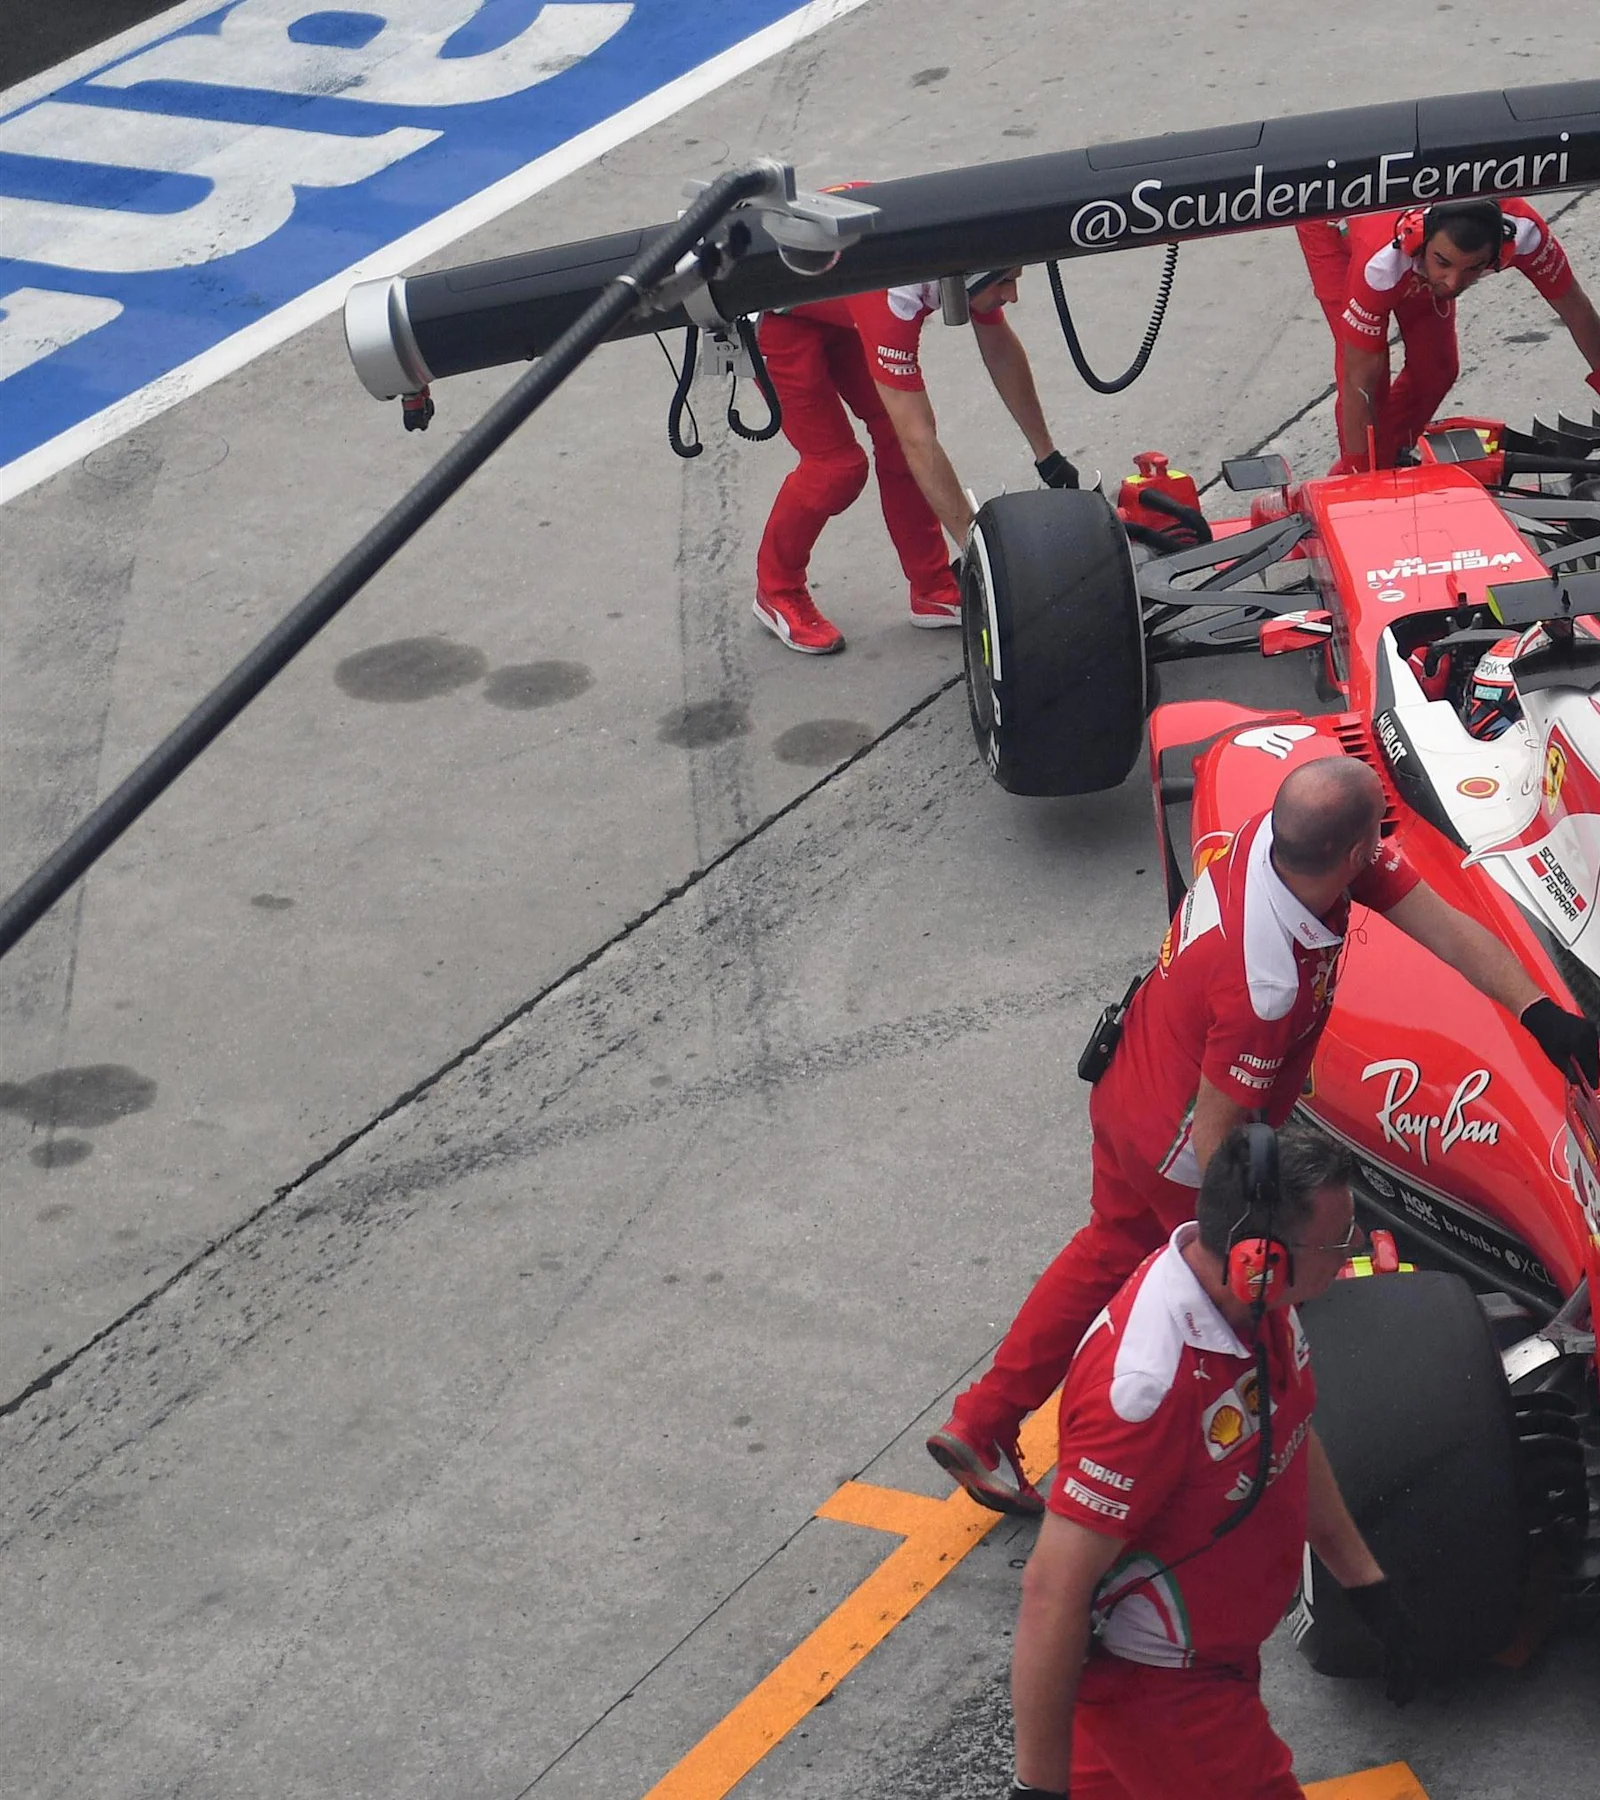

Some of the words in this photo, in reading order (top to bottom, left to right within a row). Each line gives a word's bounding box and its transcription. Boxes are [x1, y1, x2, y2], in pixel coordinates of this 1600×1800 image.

[1069, 132, 1571, 249] @ScuderiaFerrari
[877, 345, 915, 361] MAHLE
[1366, 551, 1523, 583] WEICHAI
[1376, 711, 1409, 767] HUBLOT
[1538, 845, 1578, 900] SCUDERIA
[1540, 874, 1580, 923] FERRARI
[1399, 1187, 1438, 1223] NGK
[1442, 1216, 1502, 1258] brembo
[1078, 1456, 1136, 1492] MAHLE
[1062, 1476, 1131, 1521] PIRELLI
